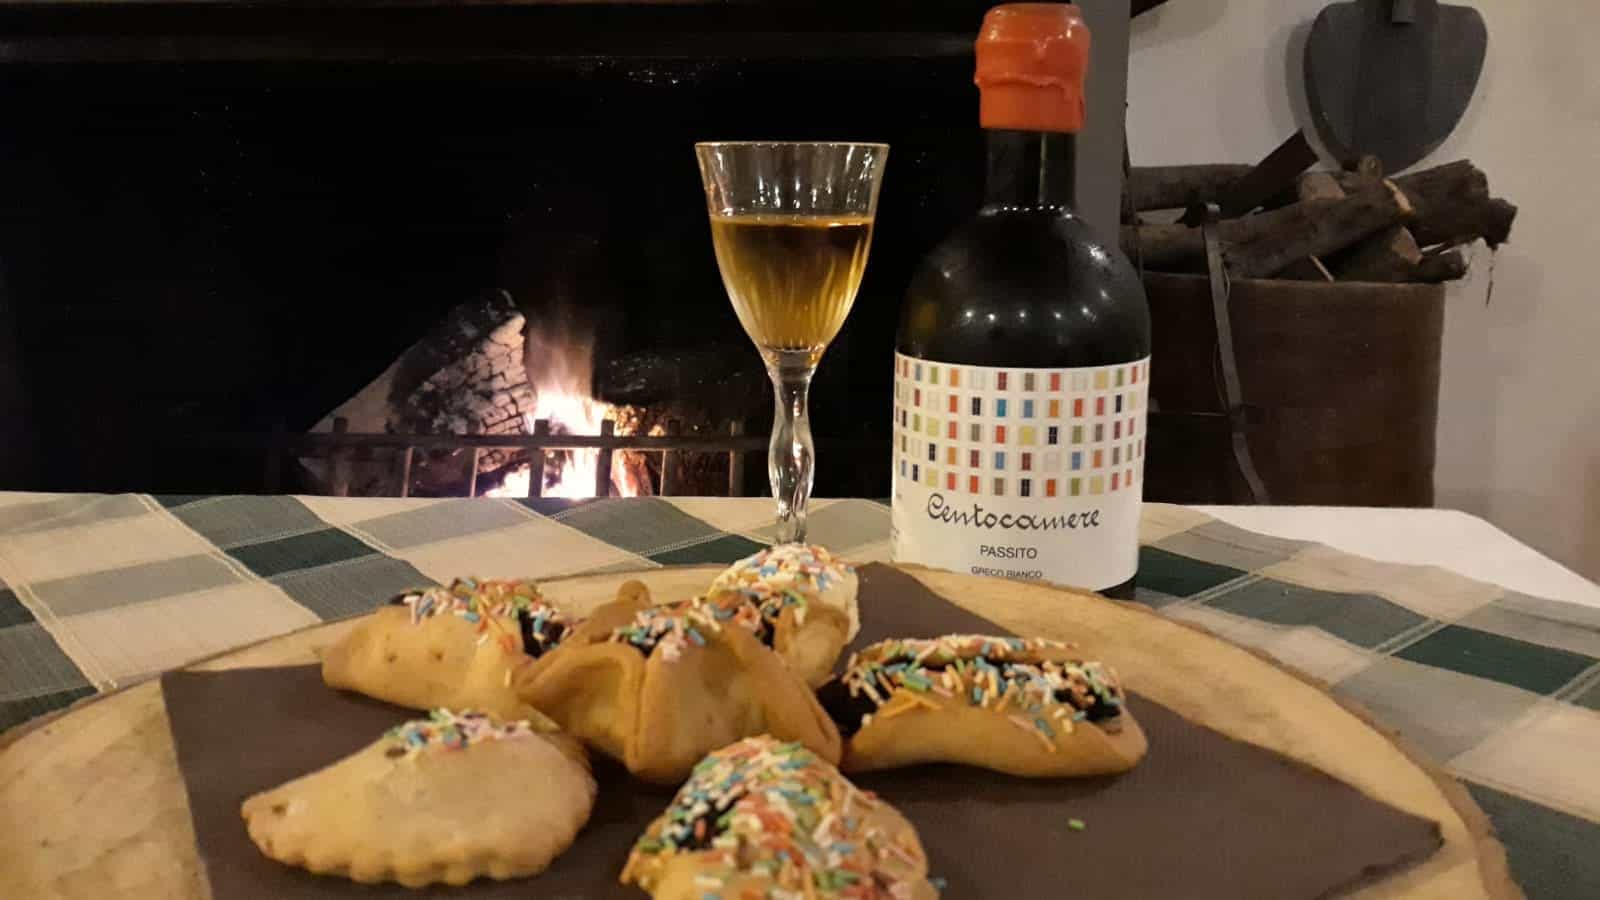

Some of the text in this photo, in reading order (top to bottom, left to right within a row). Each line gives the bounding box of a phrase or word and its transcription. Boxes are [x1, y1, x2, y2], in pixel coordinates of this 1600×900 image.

[927, 492, 1100, 530] Centocamere
[980, 544, 1038, 560] PASSITO
[971, 566, 1043, 579] GRECO BIANCO
